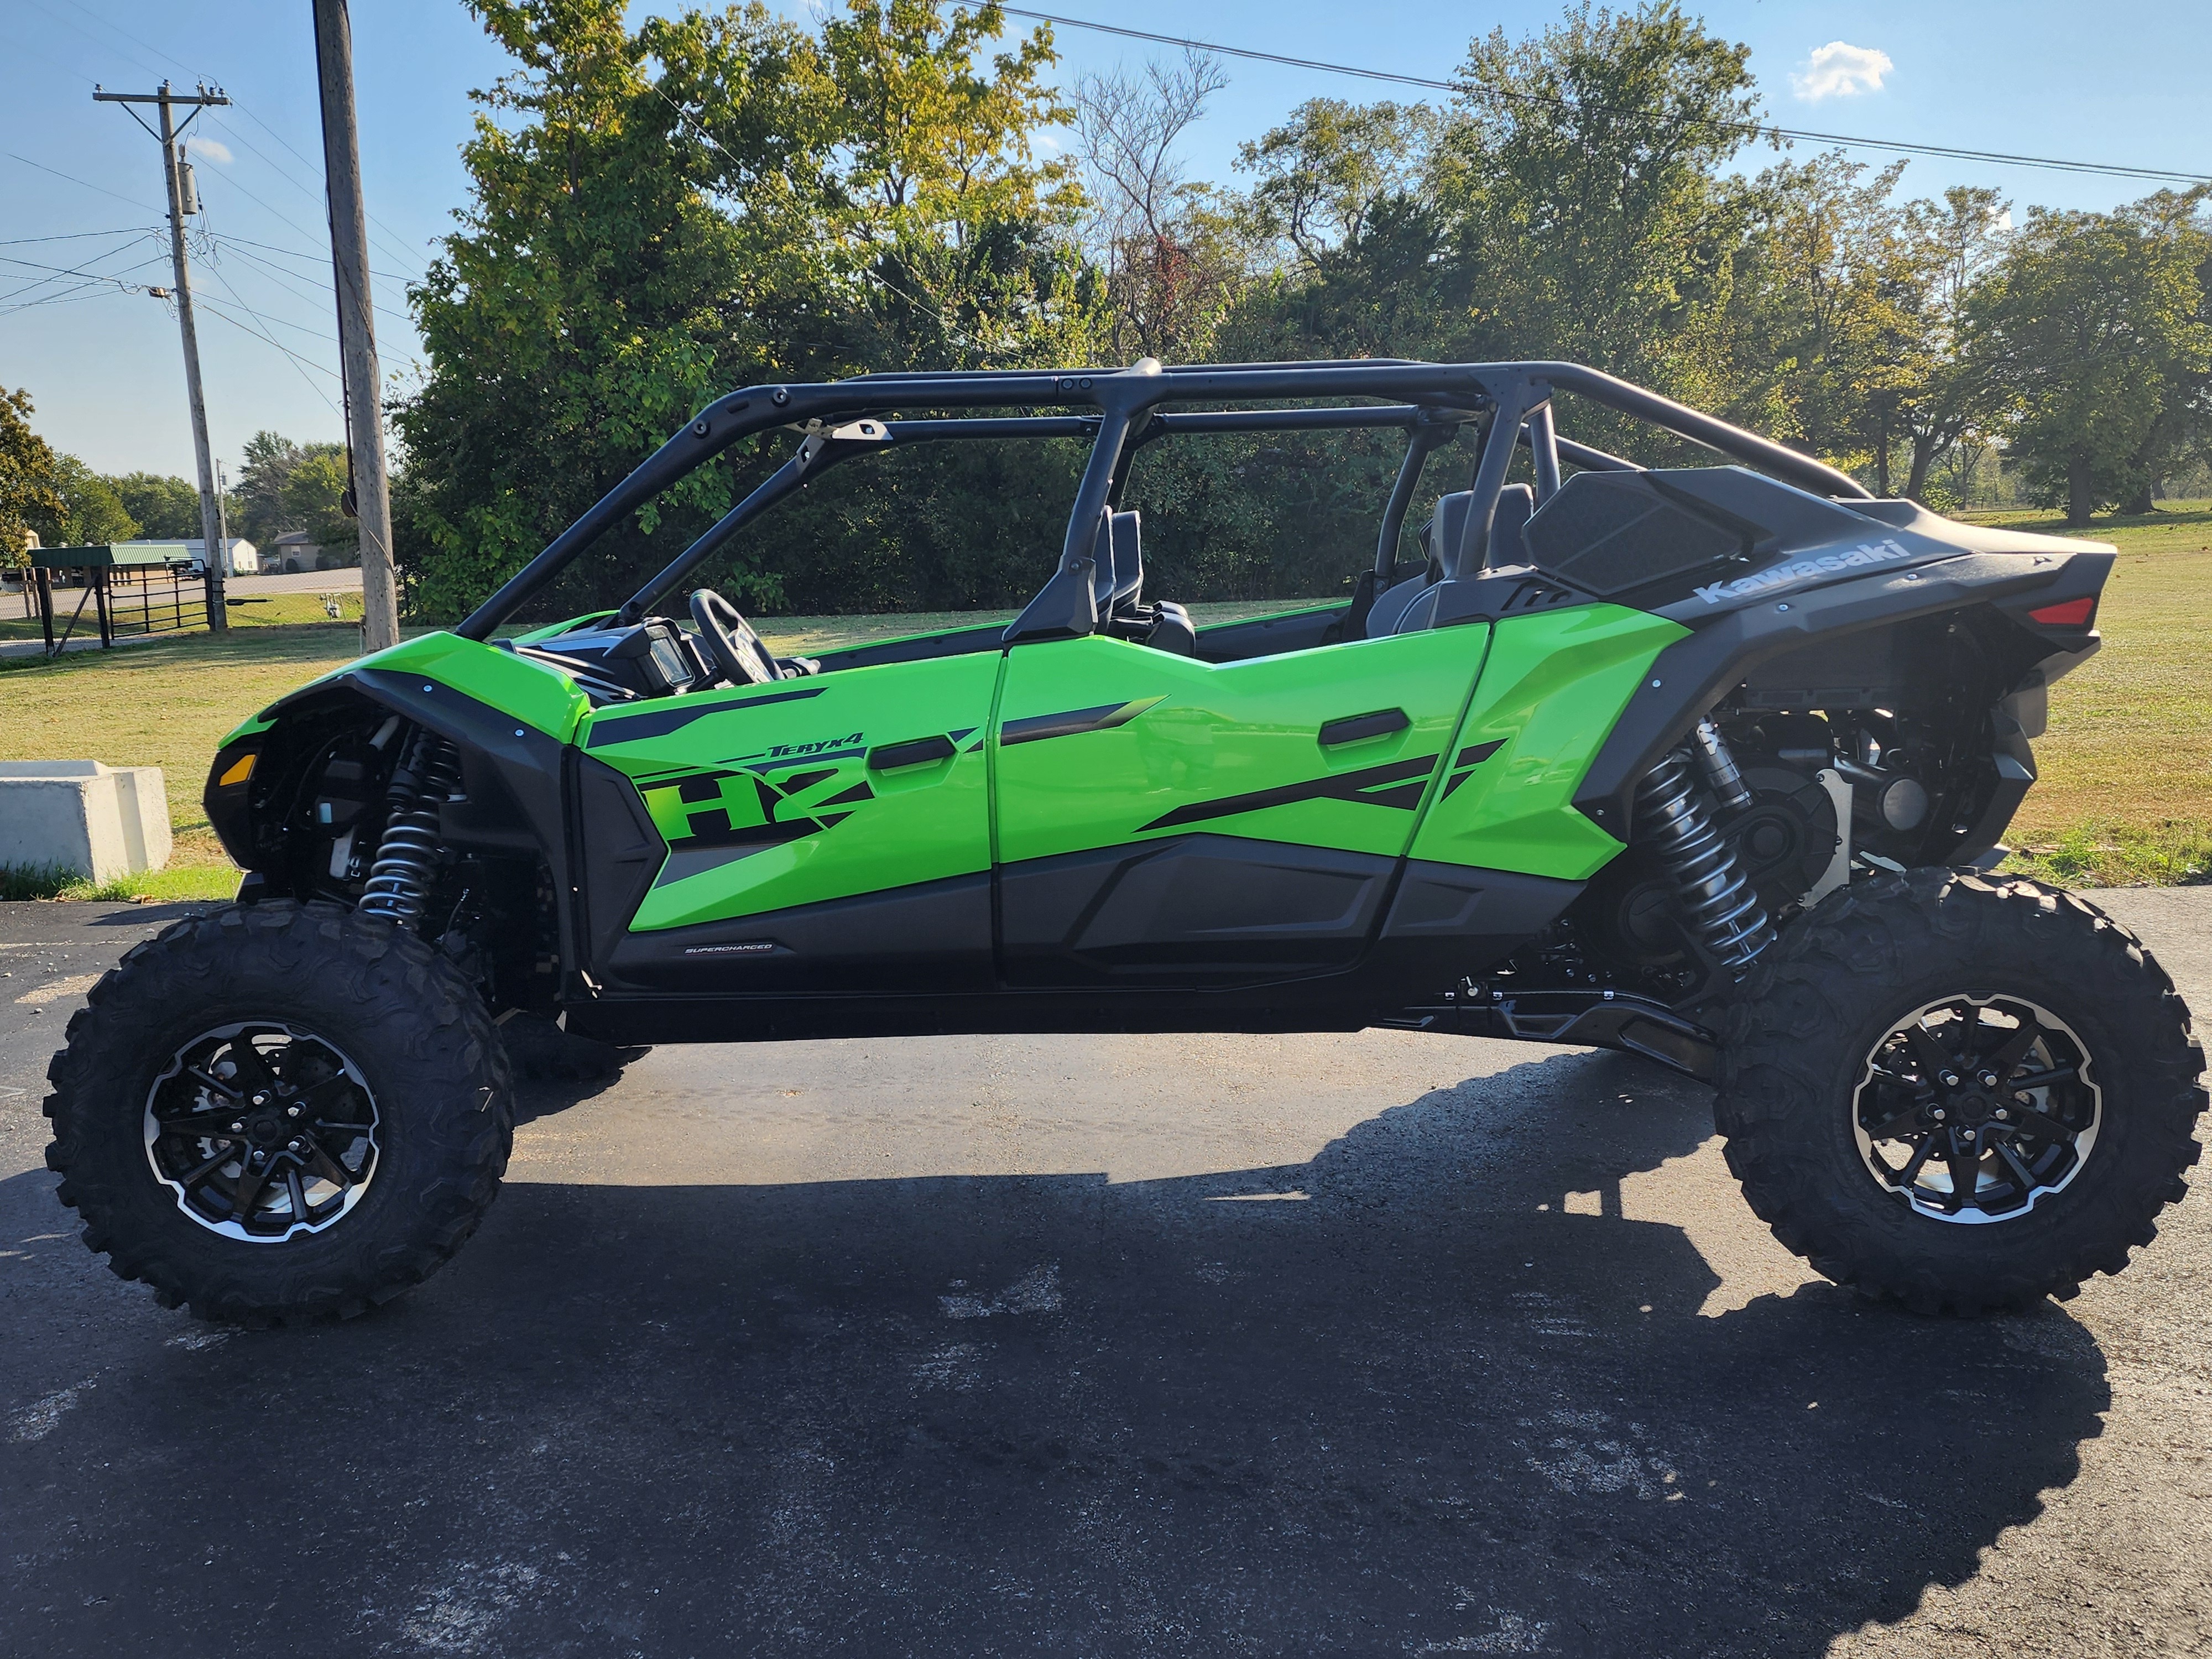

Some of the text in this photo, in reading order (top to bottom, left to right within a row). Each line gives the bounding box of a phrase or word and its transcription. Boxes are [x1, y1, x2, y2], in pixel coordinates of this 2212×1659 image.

[1693, 539, 1911, 604] Kawasaki
[641, 757, 875, 841] H2
[685, 944, 772, 953] SUPERCHARGED
